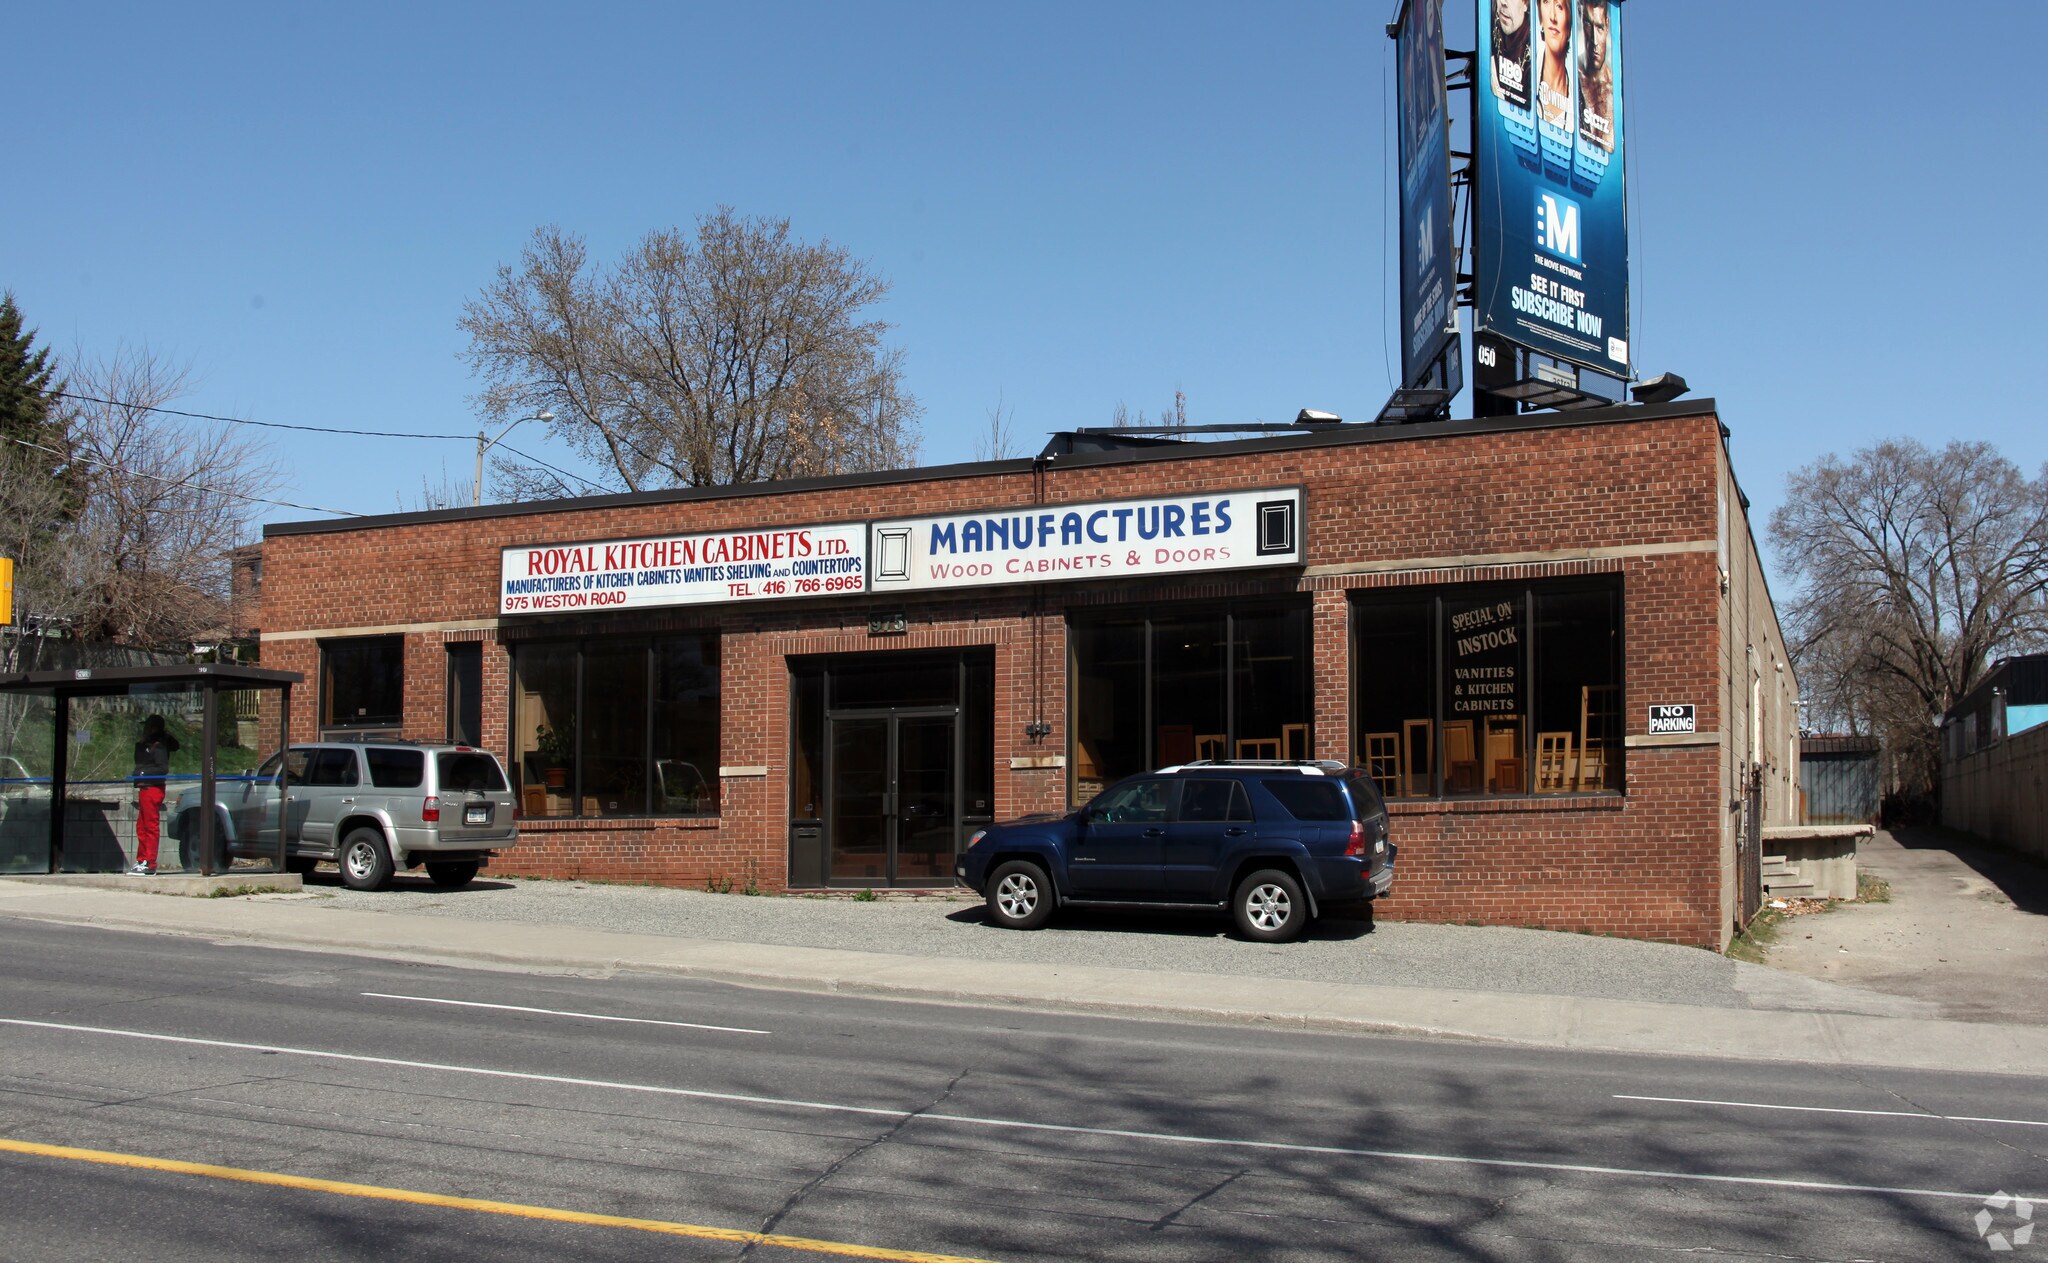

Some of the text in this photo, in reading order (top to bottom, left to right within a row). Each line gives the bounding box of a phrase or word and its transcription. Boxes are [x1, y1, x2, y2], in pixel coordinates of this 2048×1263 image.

[1499, 55, 1523, 83] HBO
[1534, 254, 1582, 280] THE MOVIE NETWORK
[1530, 273, 1585, 308] SEE IT FIRST
[1511, 285, 1575, 329] SUBSCRIBE
[1577, 309, 1602, 338] NOW
[1478, 344, 1496, 368] 050
[929, 499, 1233, 556] MANUFACTURES
[528, 530, 850, 576] ROYAL KITCHEN CABINETS LTD.
[1125, 549, 1142, 566] &
[506, 556, 862, 595] MANUFACTURERS OF KITCHEN CABINETS VANITIES SHELVING AND COUNTERTOPS
[728, 575, 863, 597] TEL. (416) 766-6965
[505, 590, 627, 610] 975 WESTON ROAD
[871, 614, 904, 632] 975
[1452, 601, 1512, 629] SPECIAL ON
[1457, 626, 1518, 657] INSTOCK
[1454, 666, 1515, 679] VANITIES
[1454, 682, 1514, 695] & KITCHEN
[1454, 699, 1515, 712] CABINETS
[1659, 706, 1684, 717] NO
[1651, 716, 1693, 732] PARKING
